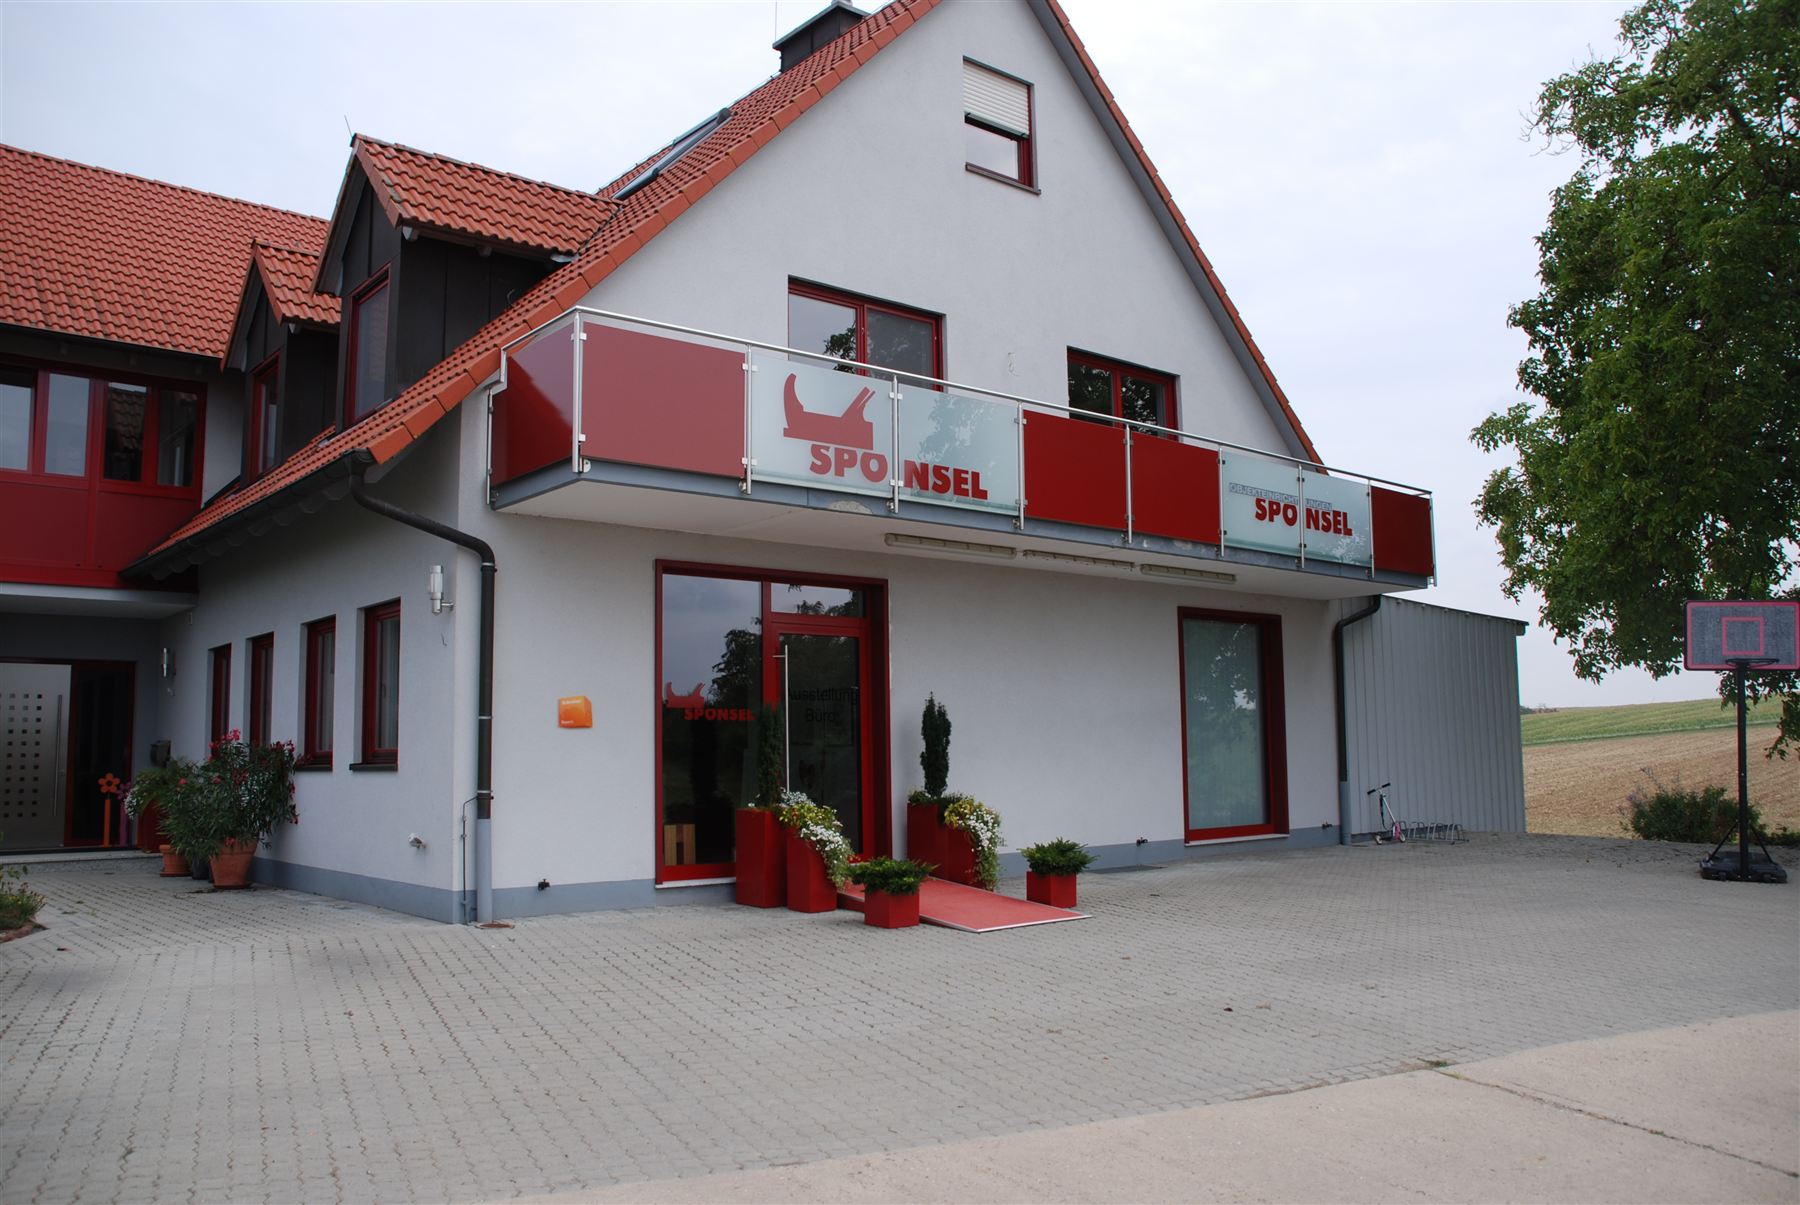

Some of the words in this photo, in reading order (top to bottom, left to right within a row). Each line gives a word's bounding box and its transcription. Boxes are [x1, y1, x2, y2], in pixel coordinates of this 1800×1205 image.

[809, 443, 988, 500] SPONSEL
[1255, 497, 1353, 536] SPONSEL
[684, 708, 757, 720] SPONSEL
